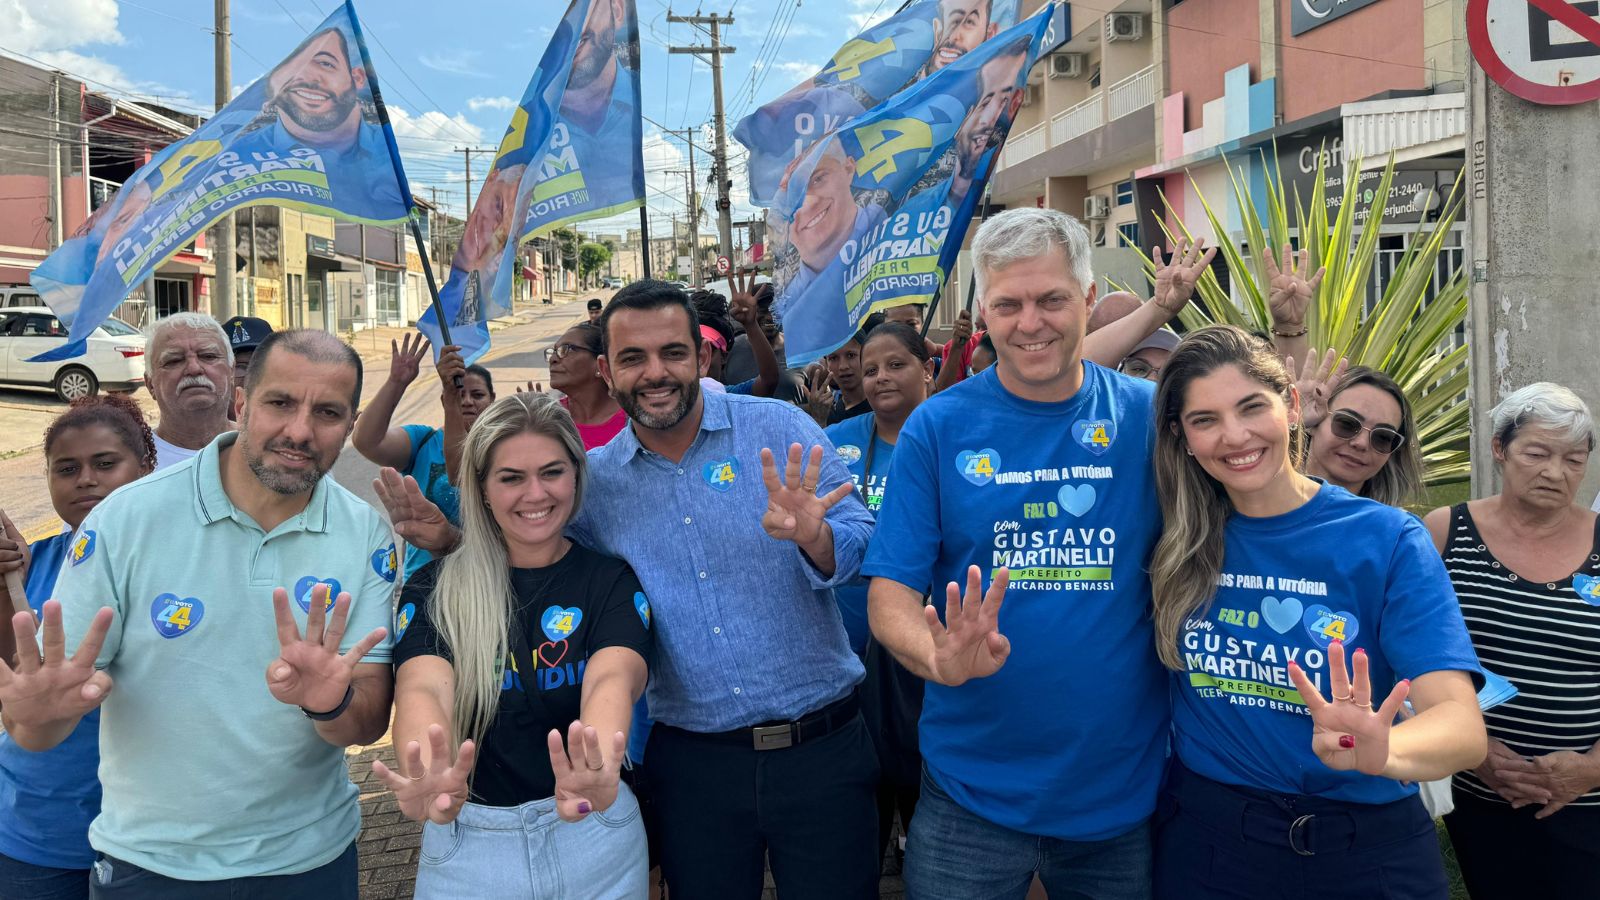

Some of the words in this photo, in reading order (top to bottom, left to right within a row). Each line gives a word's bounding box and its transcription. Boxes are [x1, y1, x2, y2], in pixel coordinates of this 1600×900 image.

[1474, 139, 1485, 199] matra
[1081, 427, 1110, 447] 44
[711, 465, 736, 485] 44
[965, 457, 994, 477] 44
[995, 471, 1032, 485] VAMOS
[1035, 469, 1060, 482] PARA
[1062, 468, 1069, 480] A
[1071, 464, 1113, 479] VITÓRIA
[1024, 503, 1045, 519] FAZ
[1047, 502, 1058, 518] O
[994, 520, 1021, 533] com
[994, 528, 1116, 549] GUSTAVO
[992, 547, 1115, 568] MARTINELLI
[1020, 570, 1082, 578] PREFEITO
[1009, 581, 1062, 590] RICARDO
[1065, 581, 1115, 591] BENASSI
[1236, 574, 1263, 589] PARA
[1266, 576, 1275, 590] A
[1278, 577, 1328, 596] VITÓRIA
[156, 604, 191, 630] 44
[546, 614, 573, 635] 44
[1185, 618, 1215, 632] com
[1218, 607, 1245, 627] FAZ
[1247, 611, 1259, 629] O
[1310, 616, 1346, 641] 44
[1184, 631, 1324, 669] GUSTAVO
[1218, 680, 1286, 698] PREFEITO
